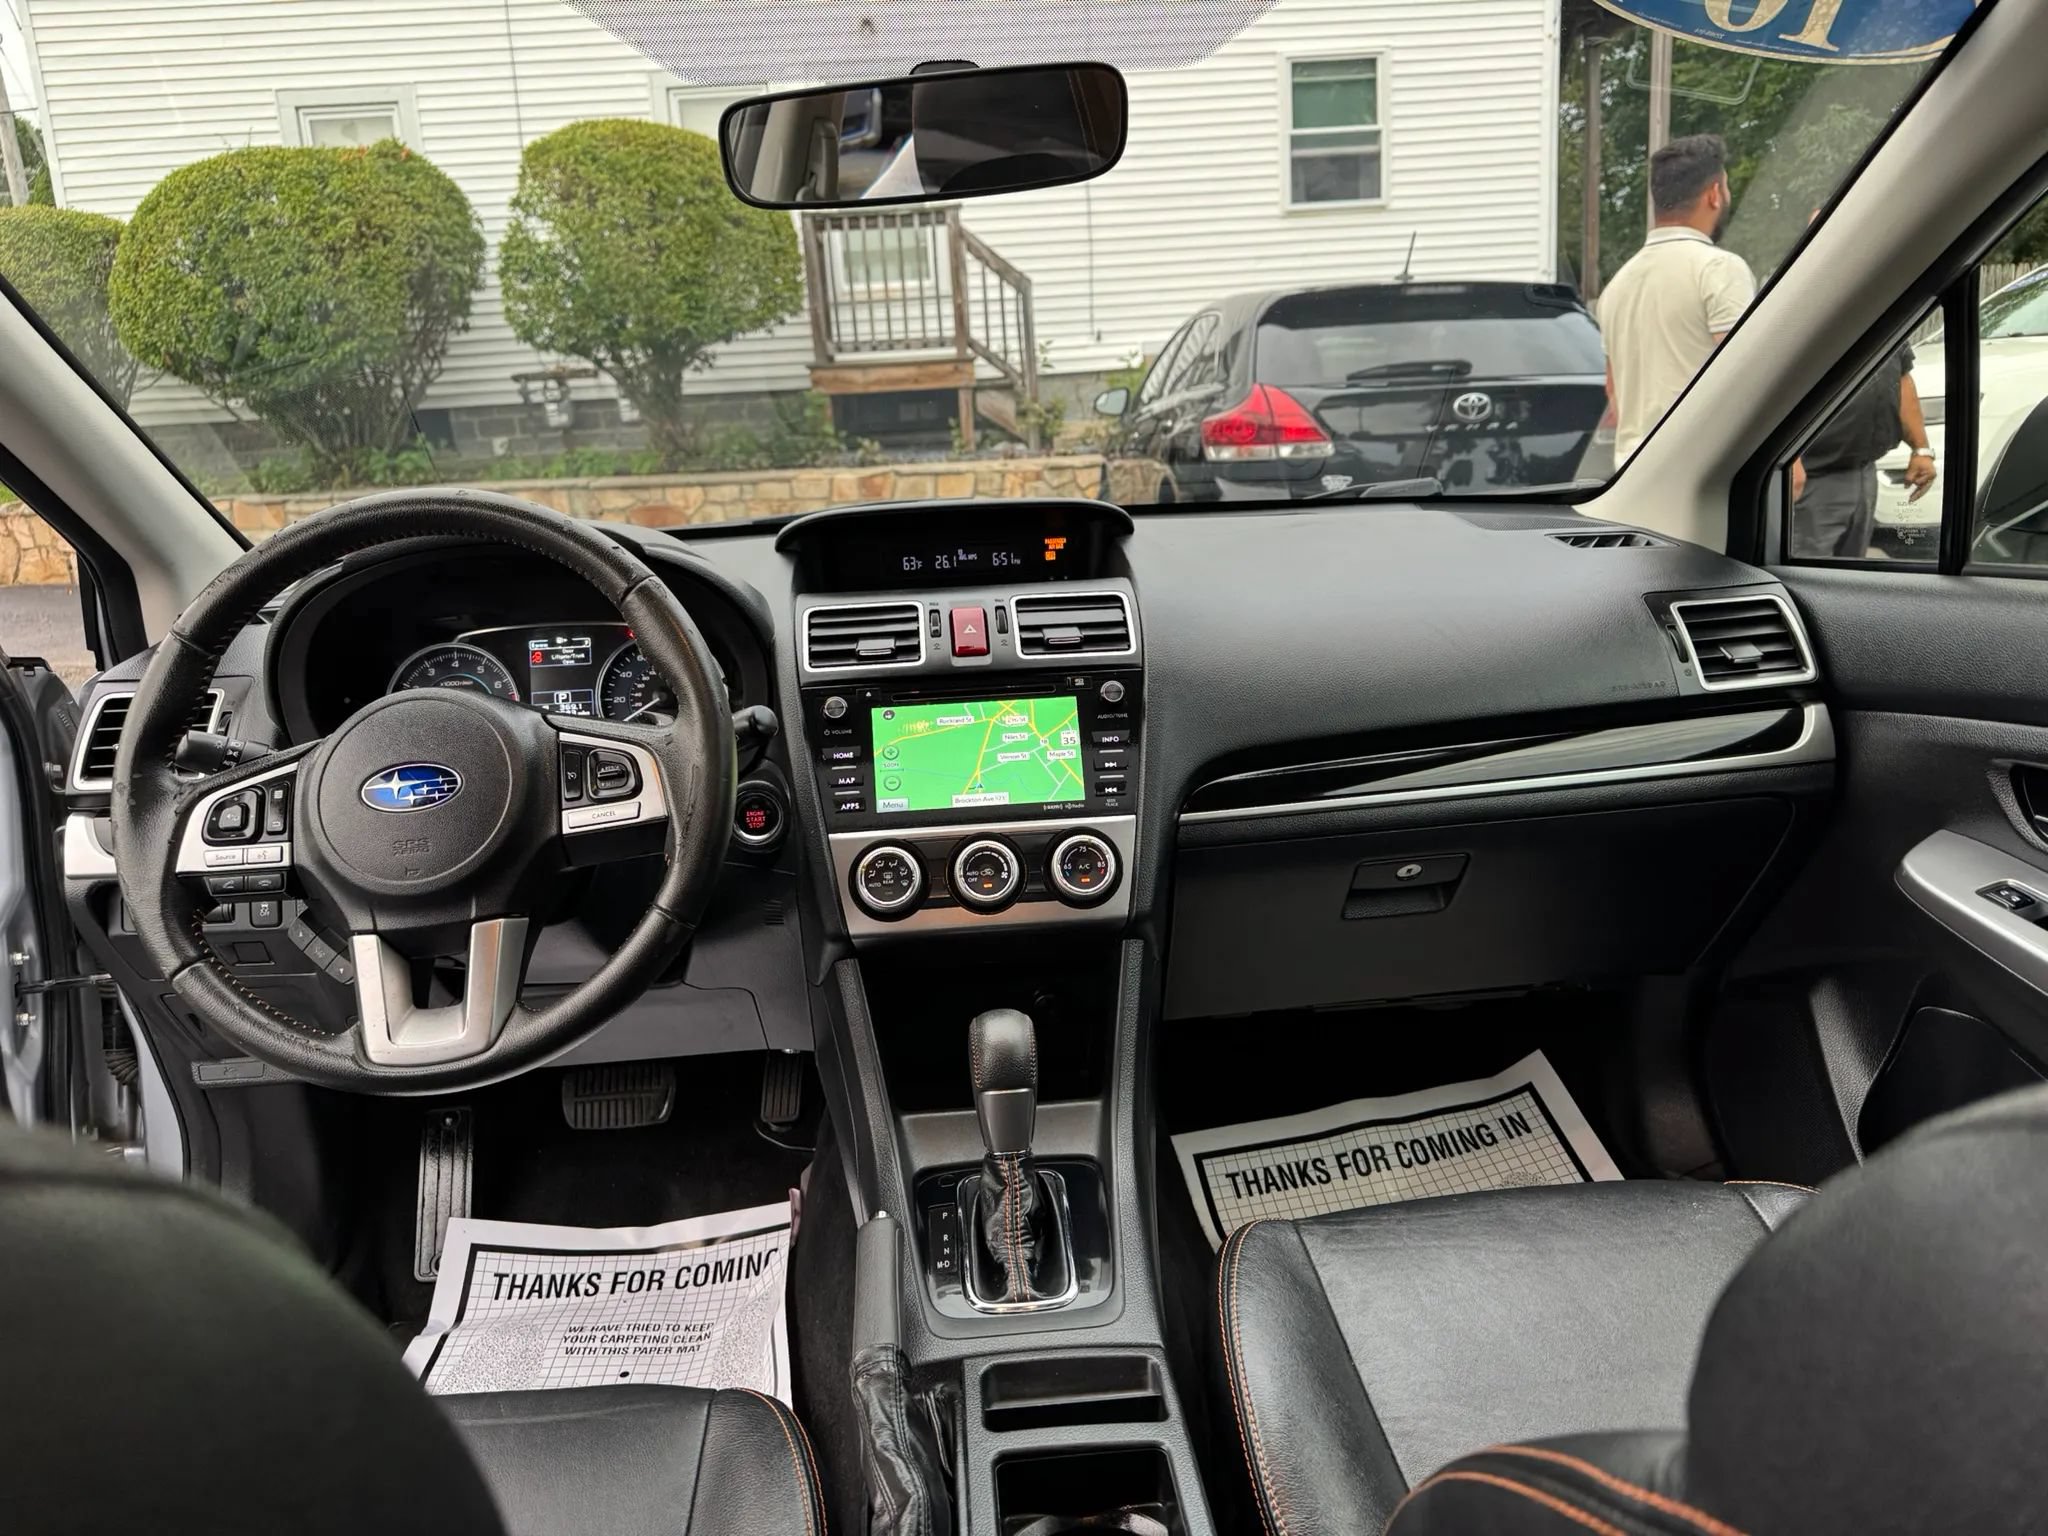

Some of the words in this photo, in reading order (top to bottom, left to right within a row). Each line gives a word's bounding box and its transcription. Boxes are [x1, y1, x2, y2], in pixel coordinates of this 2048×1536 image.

[935, 554, 957, 569] 26.1
[428, 668, 436, 676] 3
[477, 665, 485, 674] 5
[494, 680, 502, 689] 6
[1063, 737, 1076, 745] 35
[833, 751, 854, 760] HOME
[838, 777, 856, 785] MAP
[840, 802, 860, 811] APPS
[591, 810, 616, 819] CANCEL
[215, 853, 236, 861] Source
[1225, 1157, 1331, 1200] THANKS
[1335, 1145, 1391, 1180] FOR
[1397, 1123, 1499, 1170] COMING
[1499, 1111, 1533, 1140] IN
[493, 1272, 600, 1301] THANKS
[610, 1269, 666, 1295] FOR
[568, 1325, 589, 1333] WE
[626, 1323, 661, 1332] TRIED
[665, 1323, 681, 1332] TO
[684, 1321, 714, 1332] KEEP
[563, 1335, 597, 1343] YOUR
[600, 1334, 669, 1343] CARPETING
[672, 1332, 712, 1343] CLEAN
[565, 1346, 597, 1355] WITH
[601, 1346, 629, 1355] THIS
[633, 1346, 673, 1355] PAPER
[676, 1344, 702, 1354] MAT
